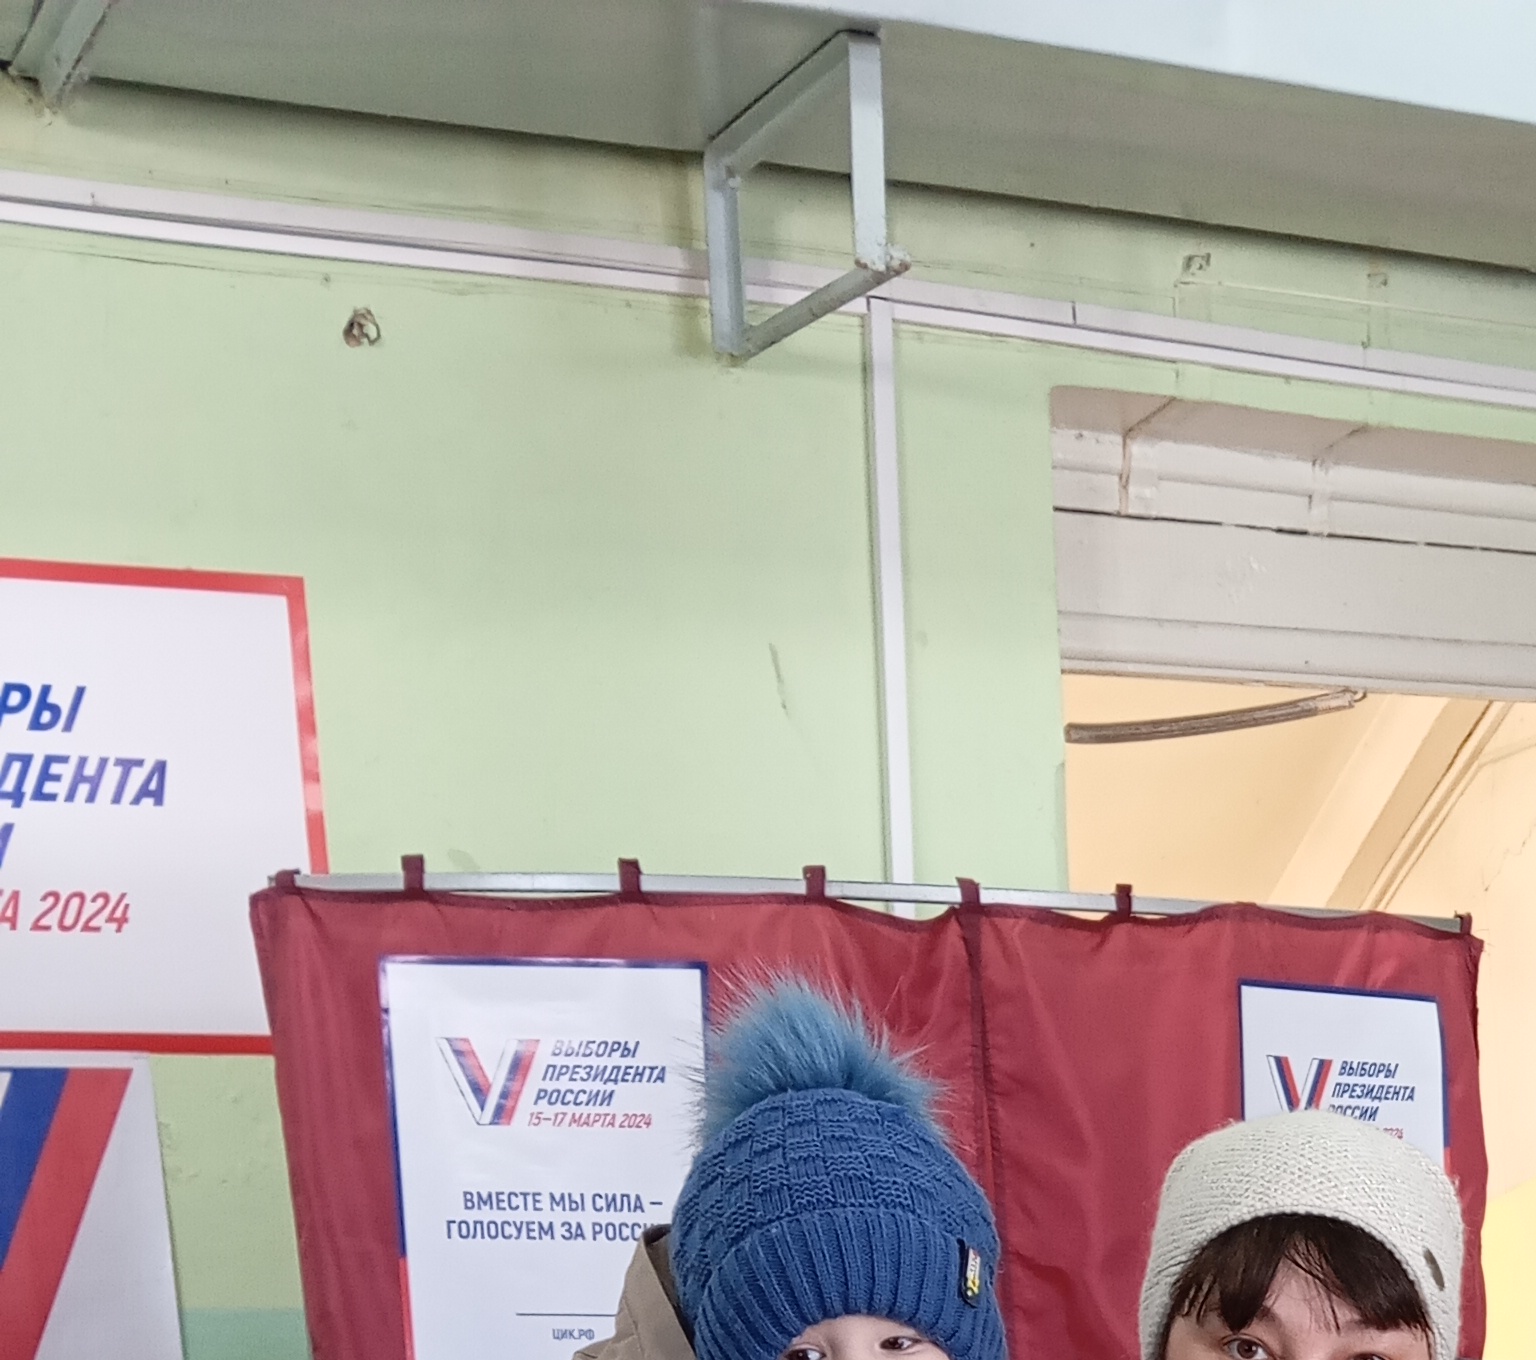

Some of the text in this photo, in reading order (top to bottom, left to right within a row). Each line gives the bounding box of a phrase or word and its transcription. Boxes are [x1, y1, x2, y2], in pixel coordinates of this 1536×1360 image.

[29, 889, 130, 934] 2024
[551, 1039, 640, 1058] ВЫБОРЫ
[542, 1064, 666, 1085] ПРЕЗИДЕНТА
[1338, 1060, 1399, 1079] ВЫБОРЫ
[533, 1088, 615, 1106] РОССИИ
[1331, 1082, 1415, 1102] ПРЕЗИДЕНТА
[569, 1112, 615, 1128] МАРТА
[618, 1113, 652, 1129] 2024
[463, 1190, 543, 1211] ВМЕСТЕ
[549, 1191, 585, 1212] МЫ
[592, 1193, 645, 1213] СИЛА
[446, 1219, 555, 1240] ГОЛОСУЕМ
[560, 1221, 586, 1241] ЗА
